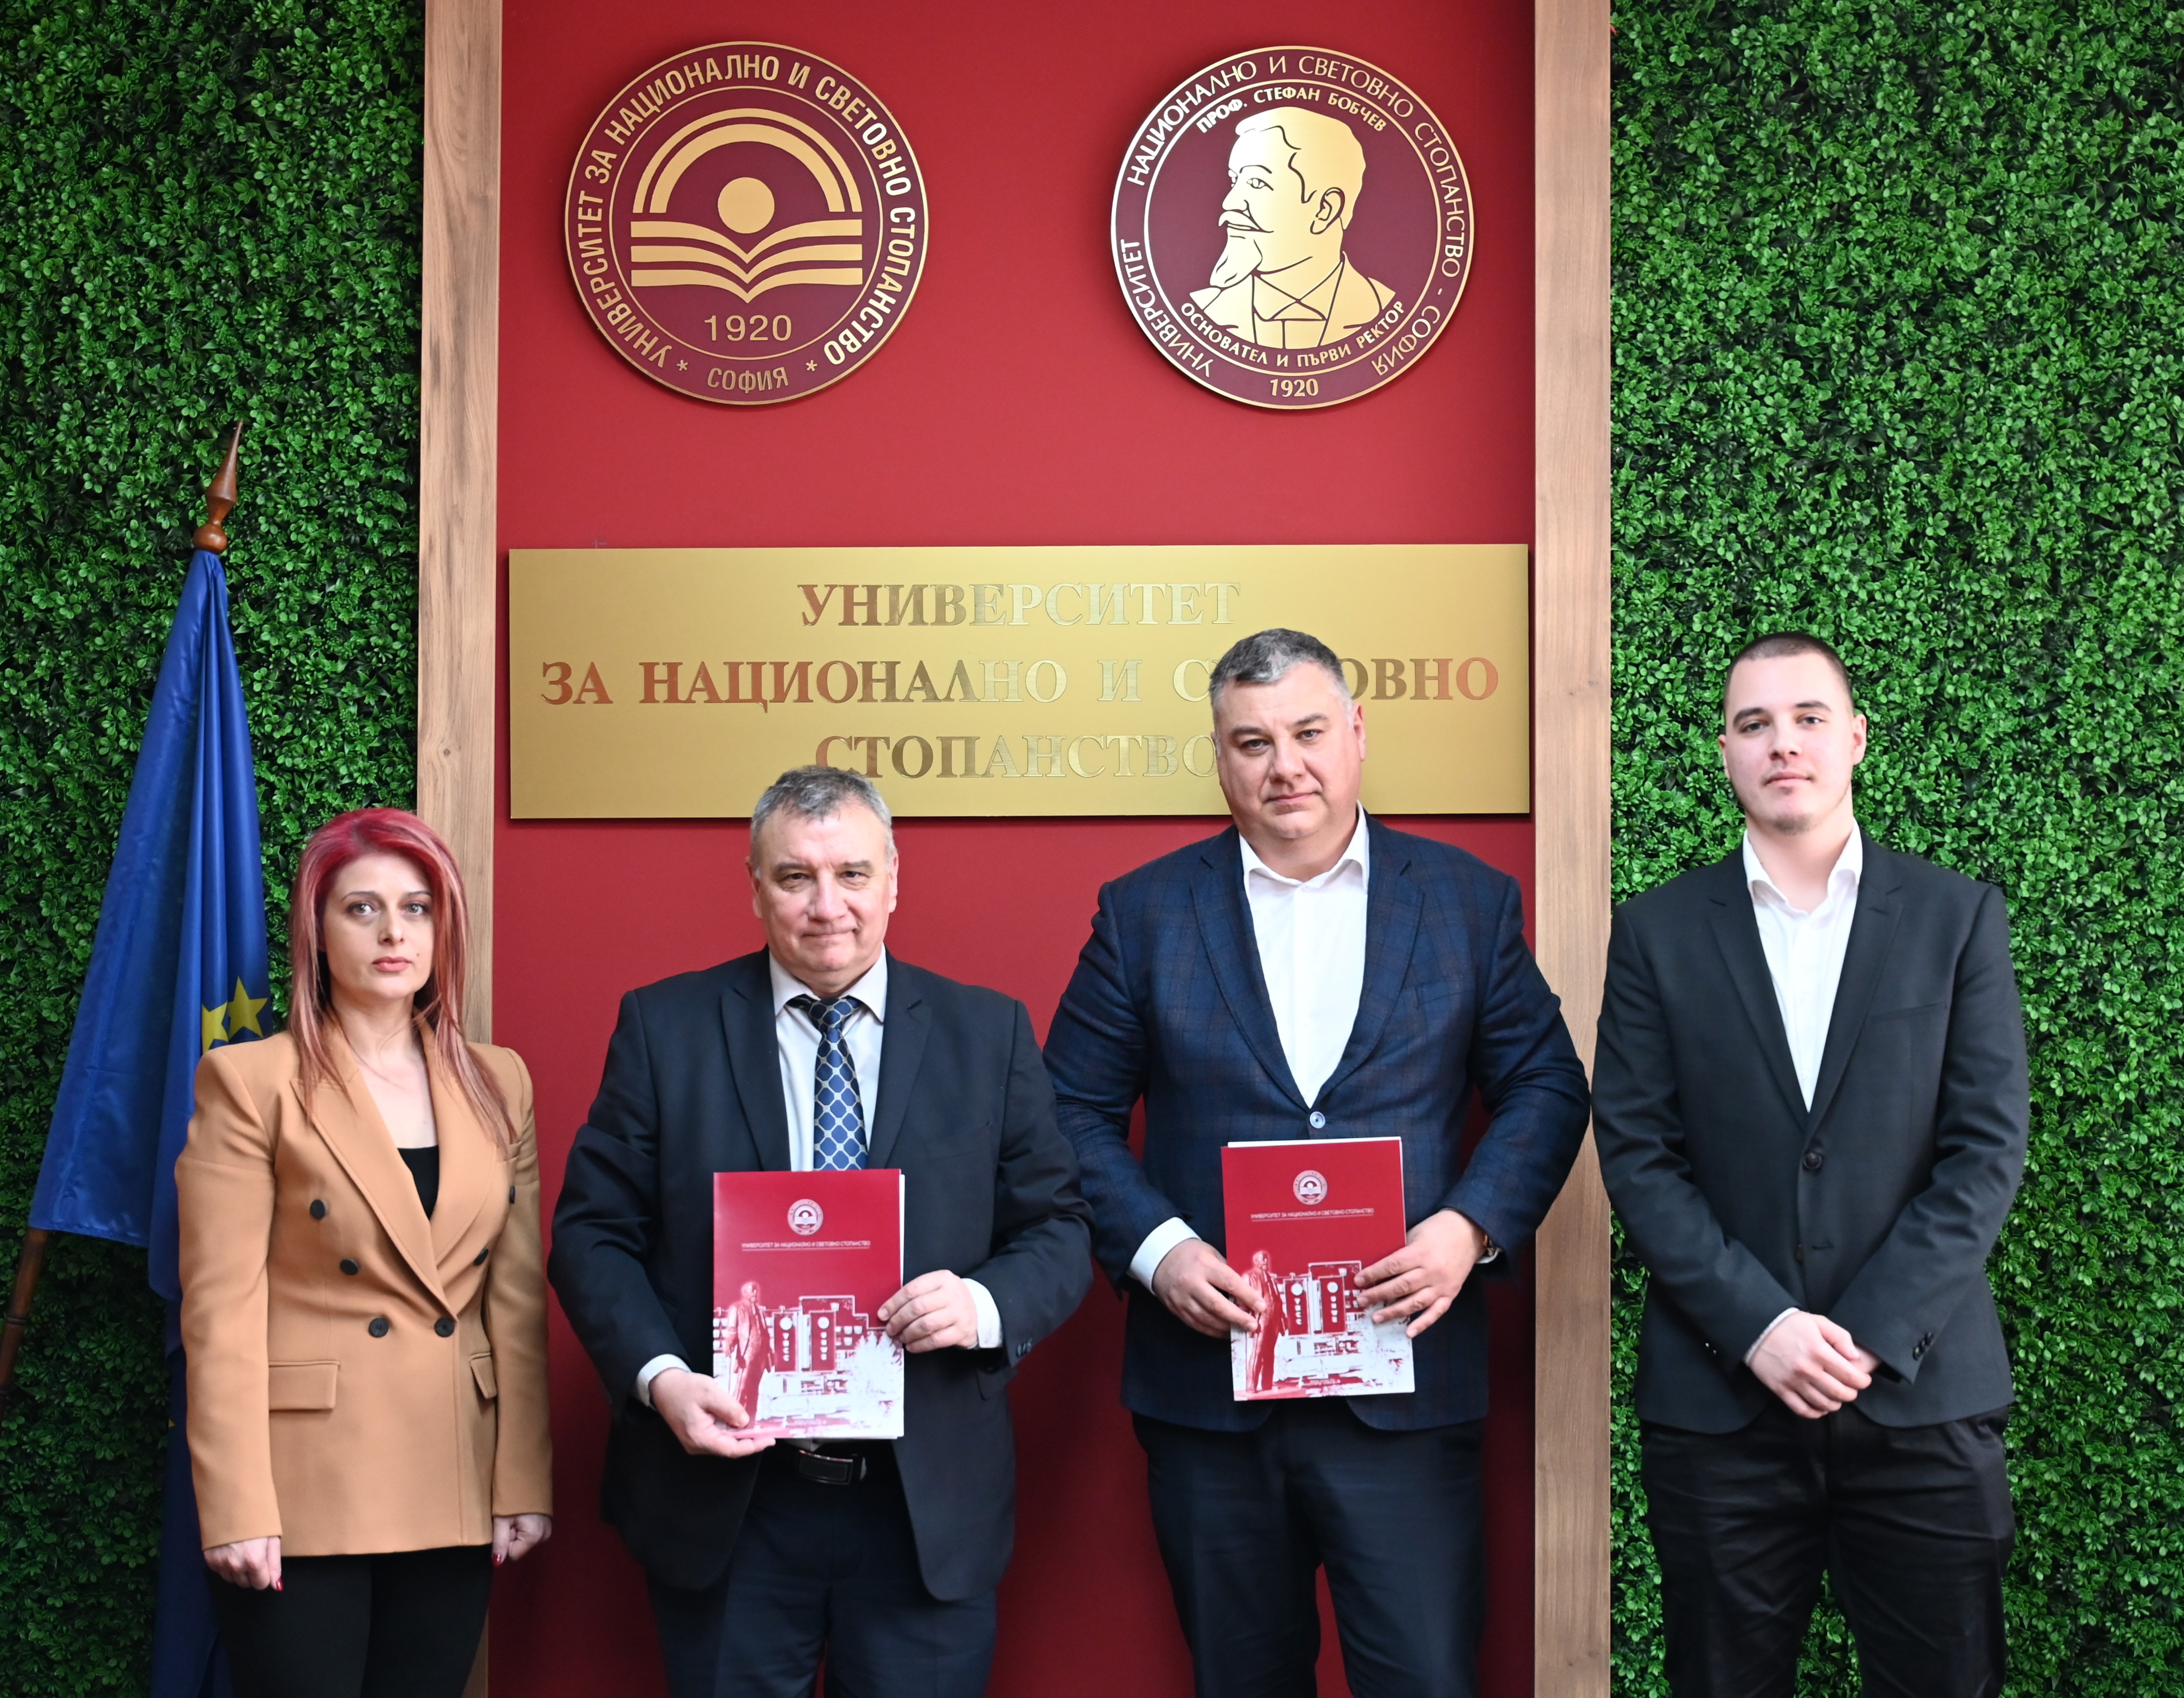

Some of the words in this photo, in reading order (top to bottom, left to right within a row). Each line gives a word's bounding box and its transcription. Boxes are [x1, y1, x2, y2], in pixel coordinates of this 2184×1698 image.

[788, 62, 811, 89] И
[1269, 56, 1286, 74] И
[1299, 55, 1414, 119] СВЕТОВНО
[604, 54, 779, 145] НАЦИОНАЛНО
[1127, 60, 1257, 186] НАЦИОНАЛНО
[1196, 98, 1248, 134] ПРОФ.
[1253, 87, 1320, 104] СТЕФАН
[1328, 92, 1387, 132] БОБЧЕВ
[815, 75, 912, 196] СВЕТОВНО
[585, 149, 617, 184] ЗА
[1414, 122, 1466, 278] СТОПАНСТВО
[578, 191, 672, 368] УНИВЕРСИТЕТ
[823, 207, 916, 365] СТОПАНСТВО
[1121, 238, 1214, 378] УНИВЕРСИТЕТ
[704, 315, 793, 342] 1920
[1181, 302, 1268, 365] ОСНОВАТЕЛ
[1276, 354, 1288, 367] И
[1297, 345, 1352, 367] ПЪРВИ
[1355, 300, 1405, 349] РЕКТОР
[1371, 304, 1441, 376] СОФИЯ
[707, 367, 790, 394] СОФИЯ
[1269, 377, 1319, 397] 1920
[797, 582, 1241, 627] УНИВЕРСИТЕТ
[541, 661, 613, 704] ЗА
[638, 659, 1067, 714] НАЦИОНАЛНО
[1097, 659, 1142, 702] И
[1173, 657, 1499, 702] СОВНО
[815, 734, 1219, 779] СТОПАНСТВО
